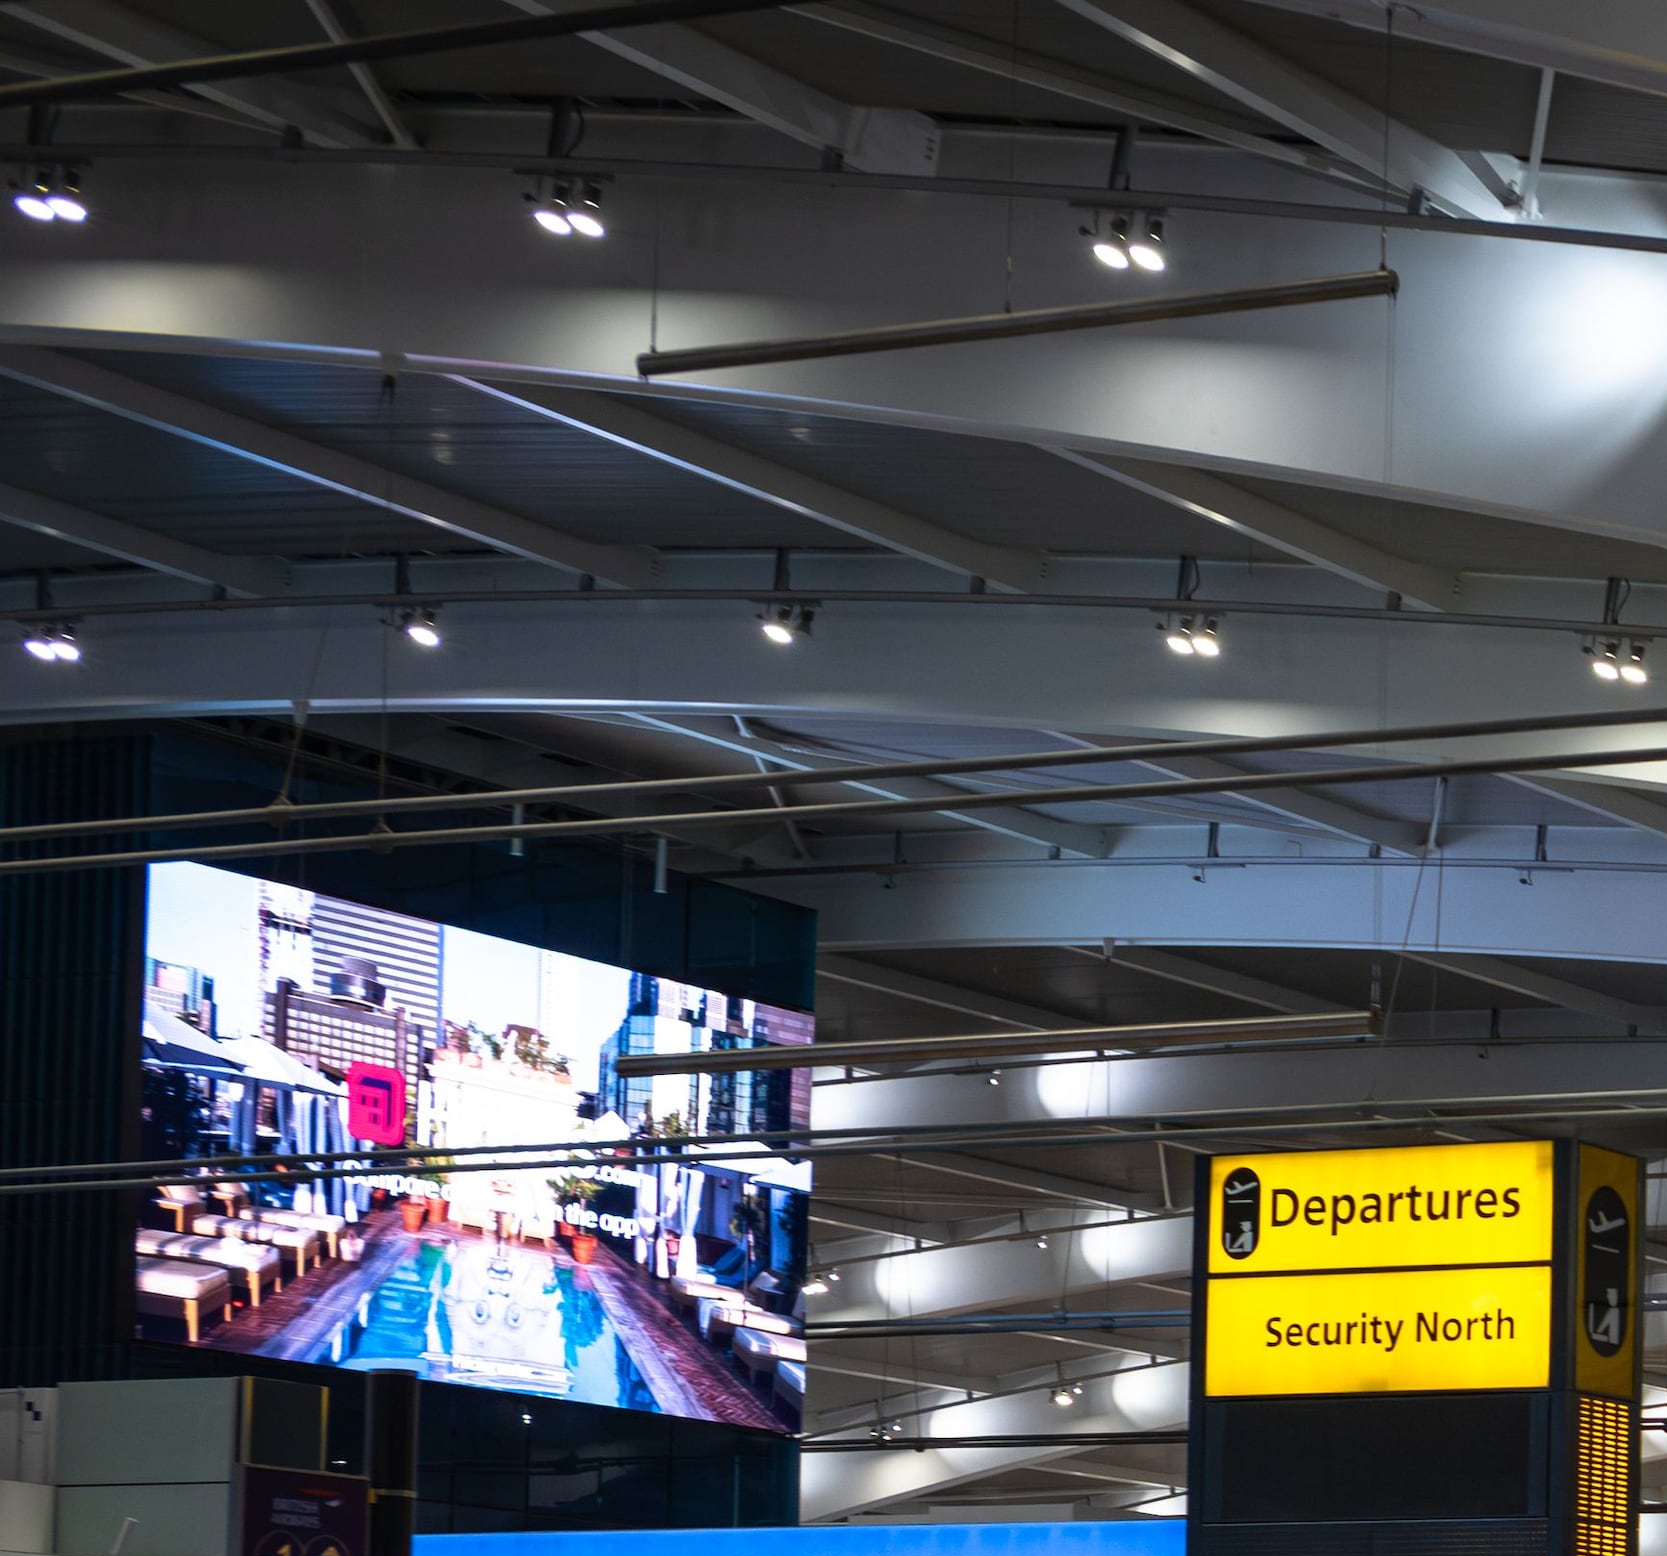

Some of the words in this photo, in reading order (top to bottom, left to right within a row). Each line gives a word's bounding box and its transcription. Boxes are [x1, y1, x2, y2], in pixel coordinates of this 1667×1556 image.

[1269, 1184, 1521, 1236] Departures
[1266, 1312, 1404, 1353] Security
[1416, 1308, 1516, 1343] North
